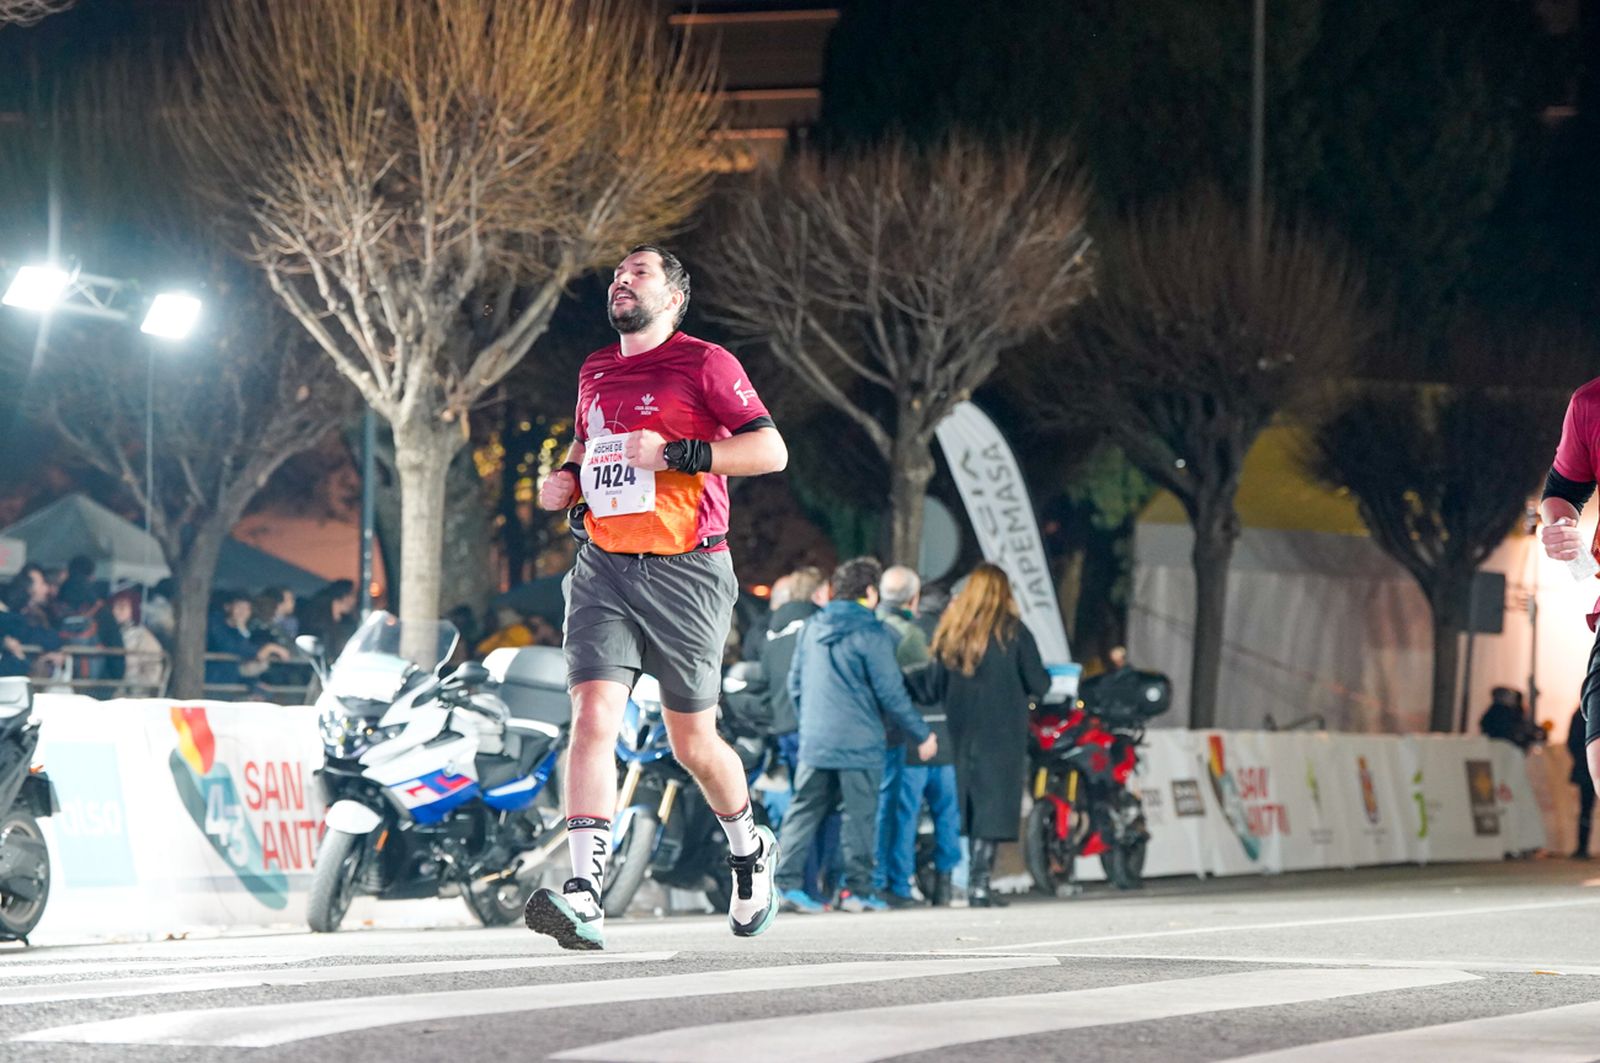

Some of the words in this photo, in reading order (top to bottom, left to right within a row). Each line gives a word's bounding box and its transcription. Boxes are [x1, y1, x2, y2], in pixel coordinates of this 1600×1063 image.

[614, 442, 623, 452] DE
[593, 463, 637, 490] 7424
[982, 442, 1052, 609] JAPEMASA
[244, 761, 304, 811] SAN
[262, 821, 326, 870] ANT
